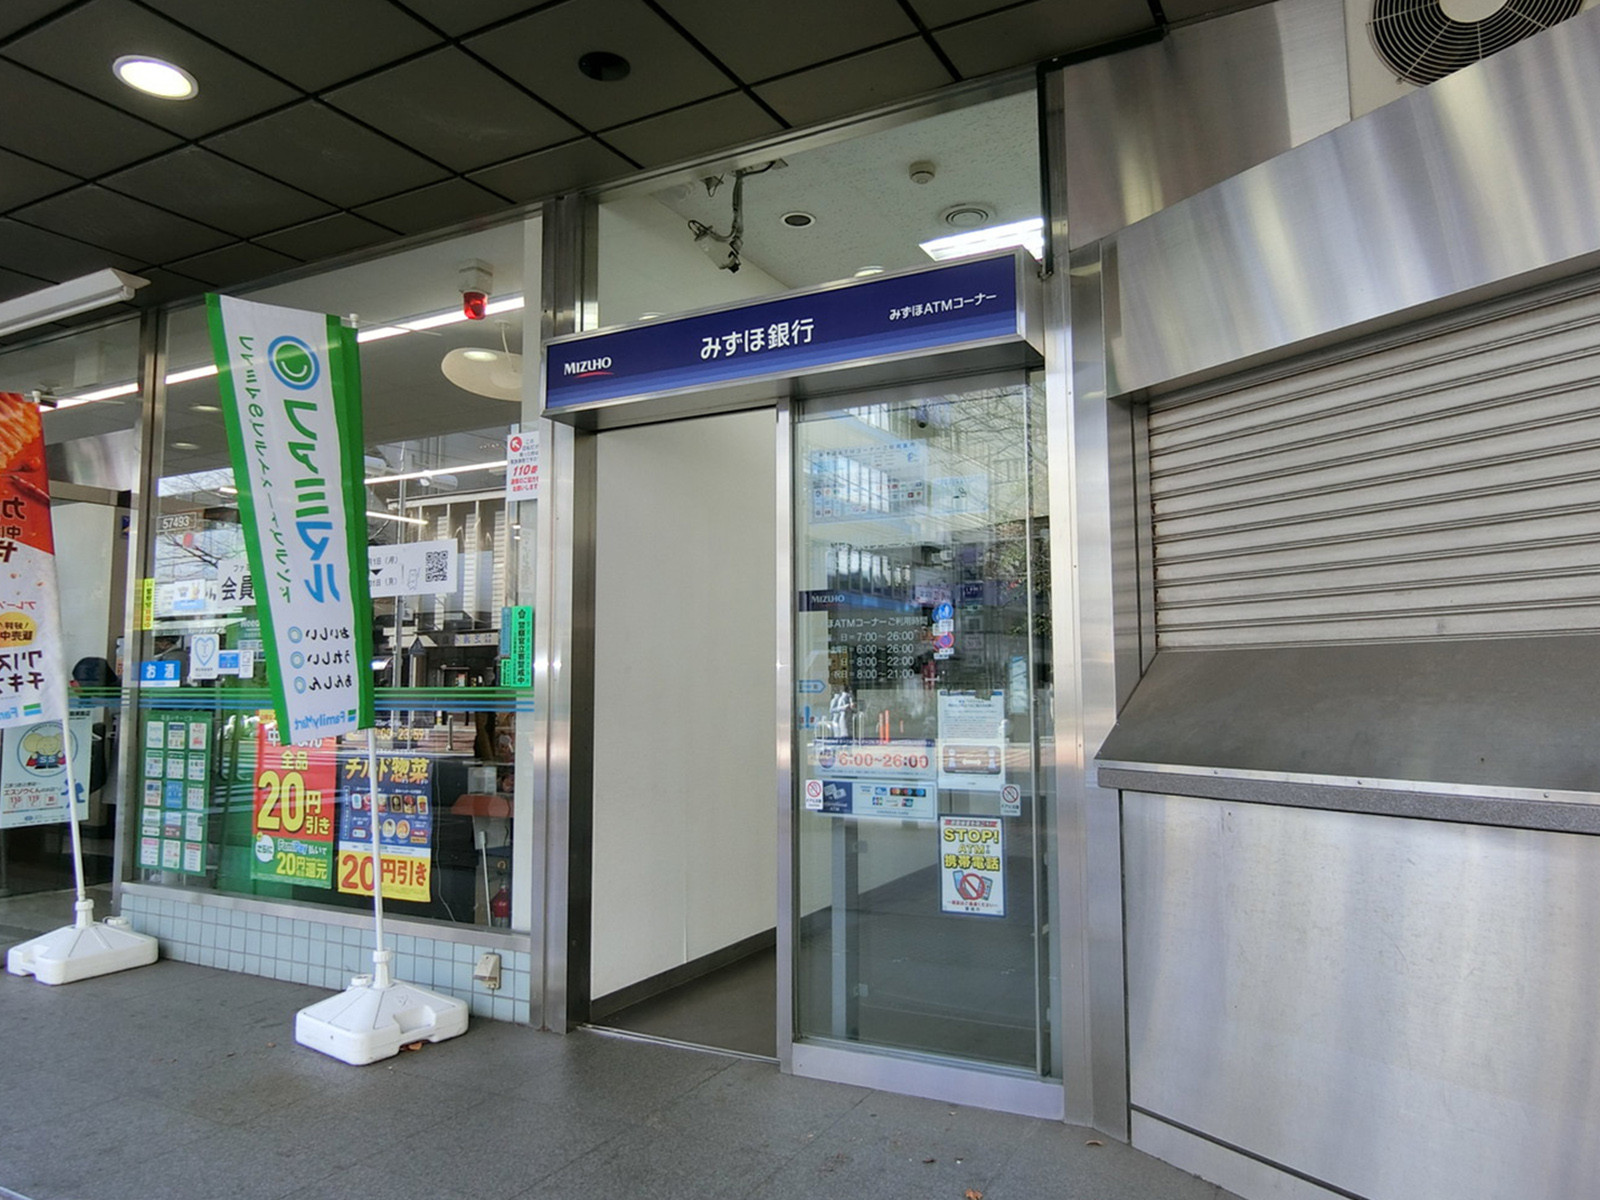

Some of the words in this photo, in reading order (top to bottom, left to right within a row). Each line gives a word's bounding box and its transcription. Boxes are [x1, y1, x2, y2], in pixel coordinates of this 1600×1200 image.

[889, 293, 997, 321] みずほATMコーナー
[700, 318, 815, 360] みずほ銀行
[563, 355, 612, 377] MIZUHO
[162, 516, 190, 529] 57493
[221, 575, 255, 601] 会員
[811, 594, 846, 603] MIZUHO
[146, 662, 176, 679] お酒
[281, 750, 309, 771] 全品
[256, 770, 331, 835] 20円引き
[943, 828, 999, 844] STOP!
[341, 853, 428, 892] 20円引き
[944, 854, 1000, 872] 携帯電話
